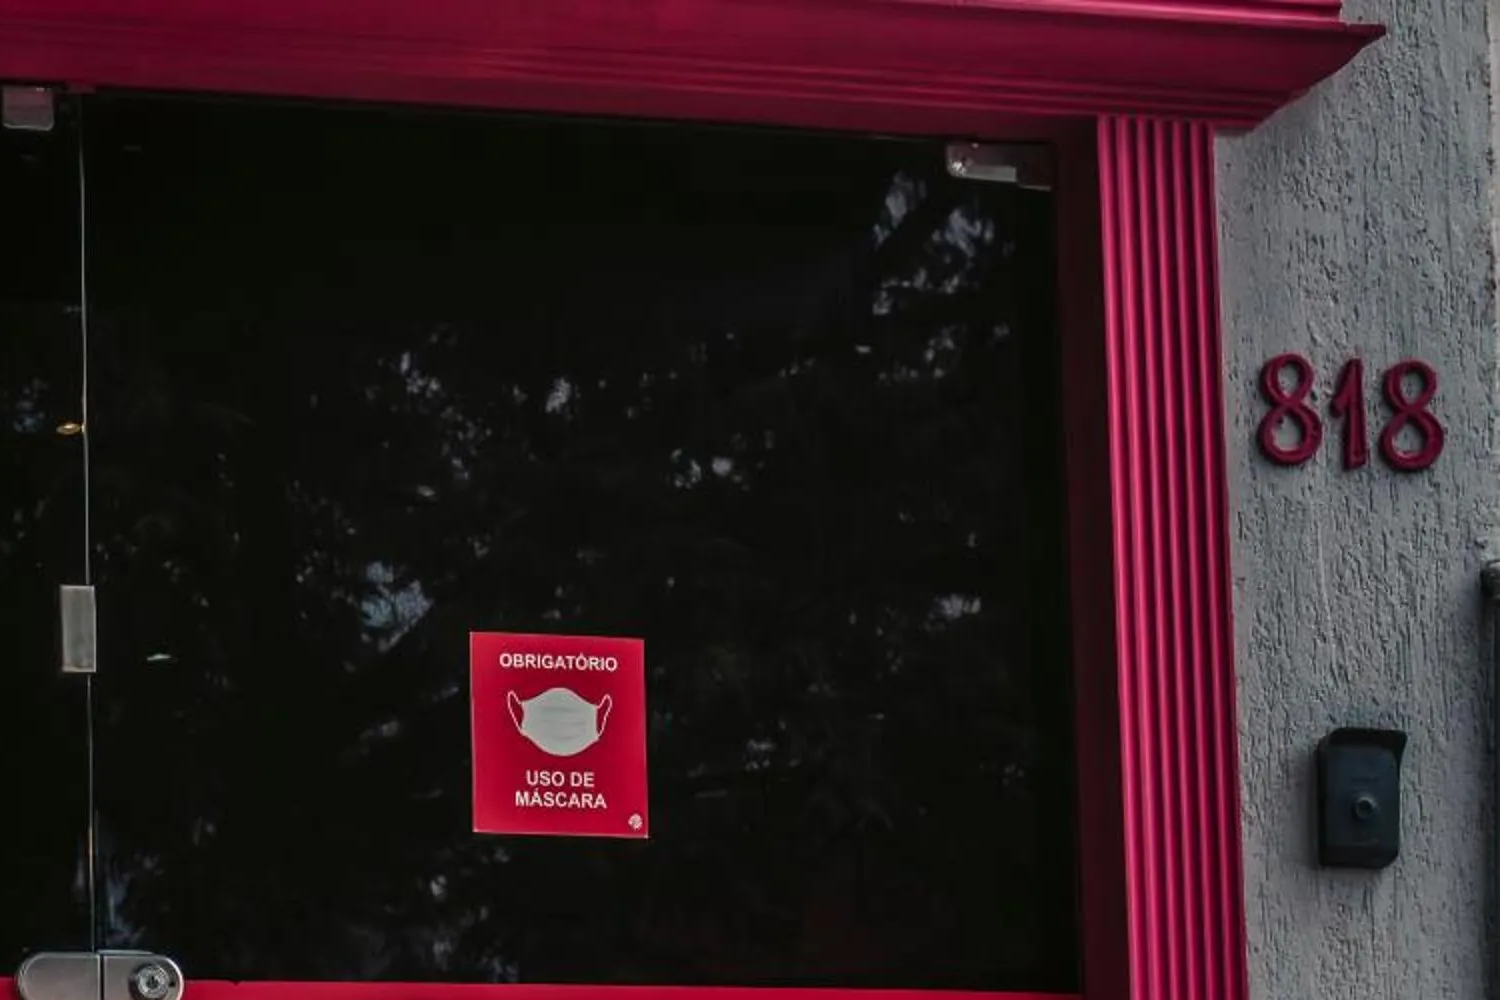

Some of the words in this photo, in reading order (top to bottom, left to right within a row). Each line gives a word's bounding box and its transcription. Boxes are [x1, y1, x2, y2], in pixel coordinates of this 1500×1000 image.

[1258, 352, 1445, 472] 818
[500, 652, 618, 672] OBRIGATÓRIO
[526, 770, 565, 787] USO
[570, 771, 595, 788] DE
[516, 788, 607, 809] MÁSCARA
